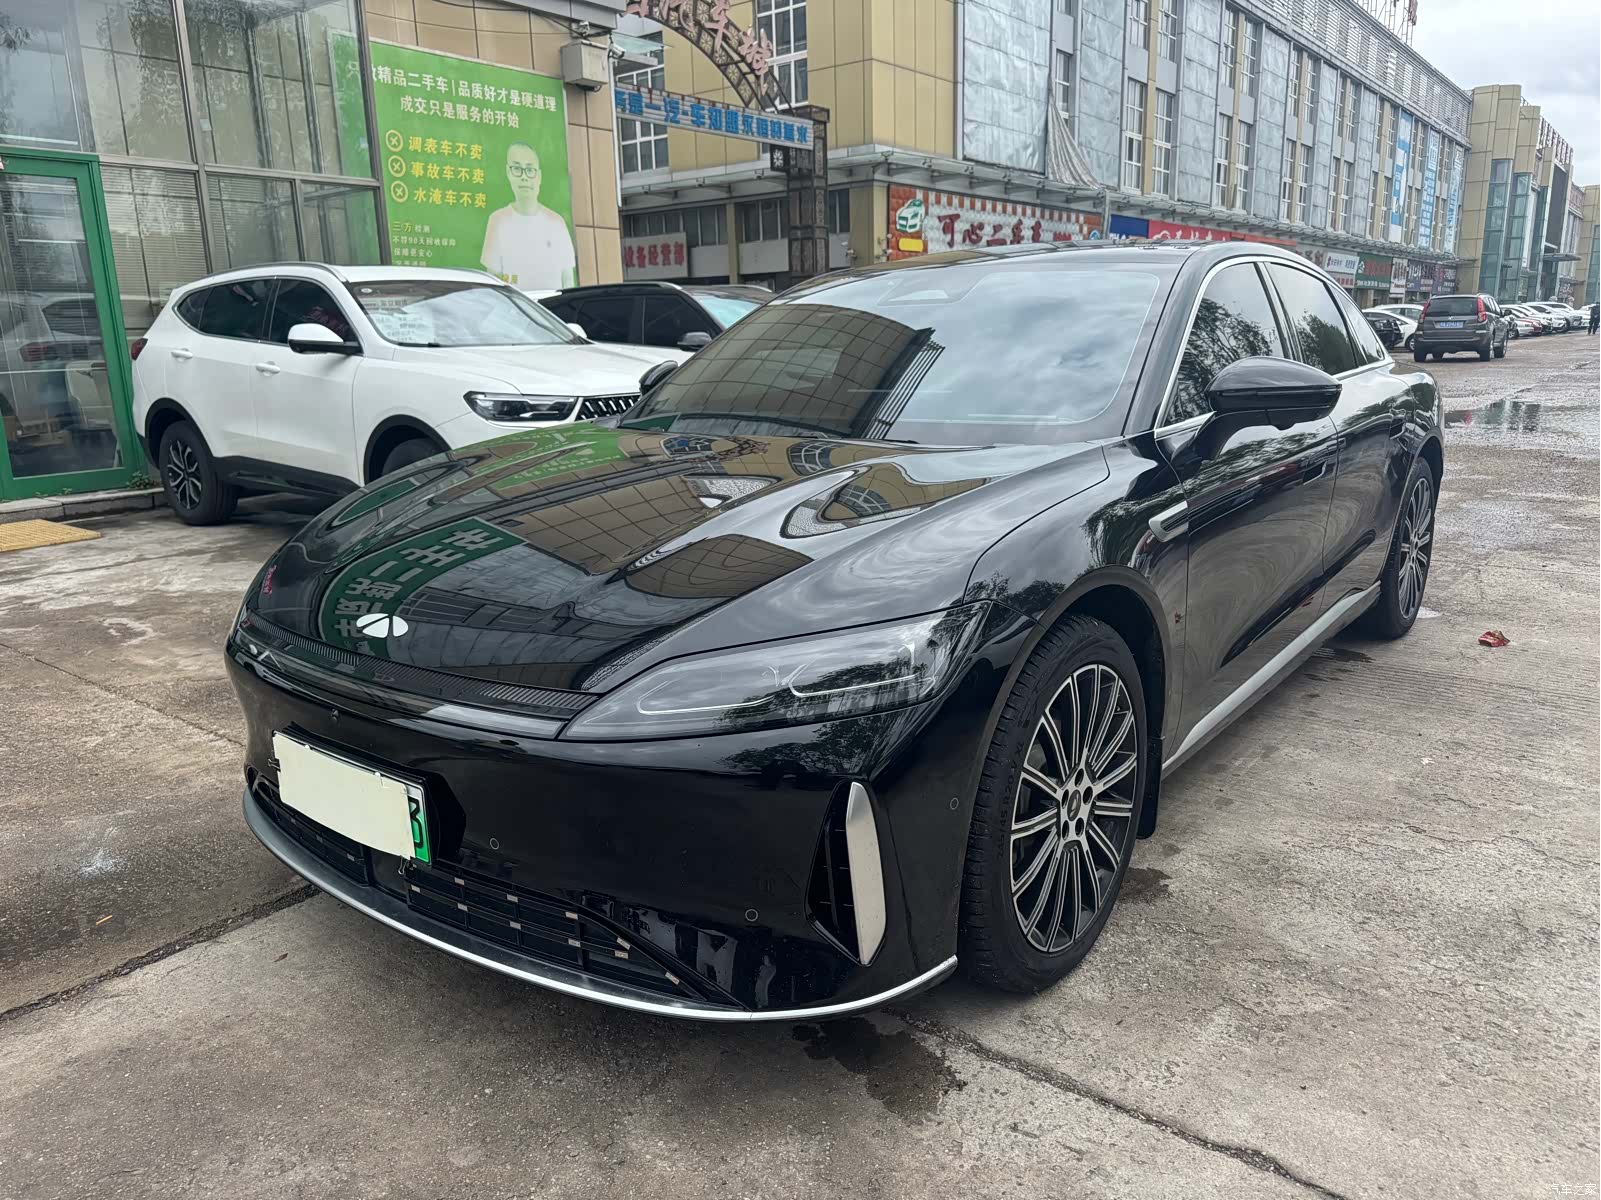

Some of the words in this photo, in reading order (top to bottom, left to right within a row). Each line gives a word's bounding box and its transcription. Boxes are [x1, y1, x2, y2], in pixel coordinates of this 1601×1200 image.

[400, 95, 520, 128] 成交只是服务的开始
[408, 136, 483, 160] 调表车不卖
[410, 161, 485, 184] 事故车不卖
[413, 187, 487, 208] 水淹车不卖
